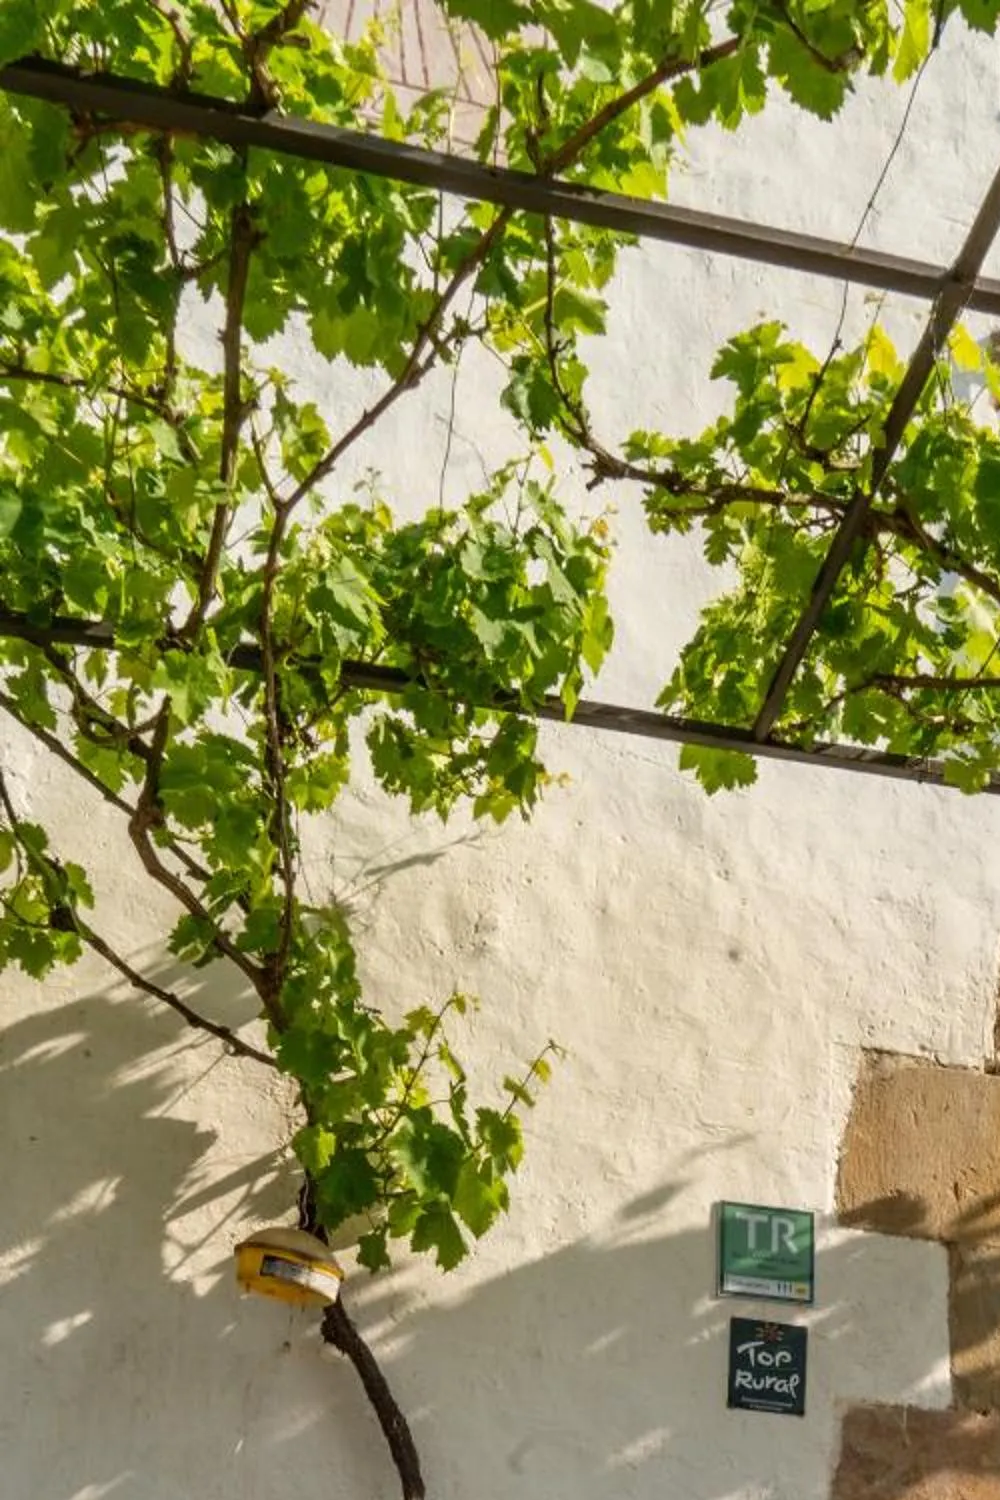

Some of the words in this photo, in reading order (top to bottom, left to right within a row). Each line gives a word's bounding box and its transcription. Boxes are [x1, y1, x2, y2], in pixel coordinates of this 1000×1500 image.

[735, 1210, 799, 1255] TR
[736, 1340, 793, 1369] Top
[734, 1367, 801, 1399] Rural
